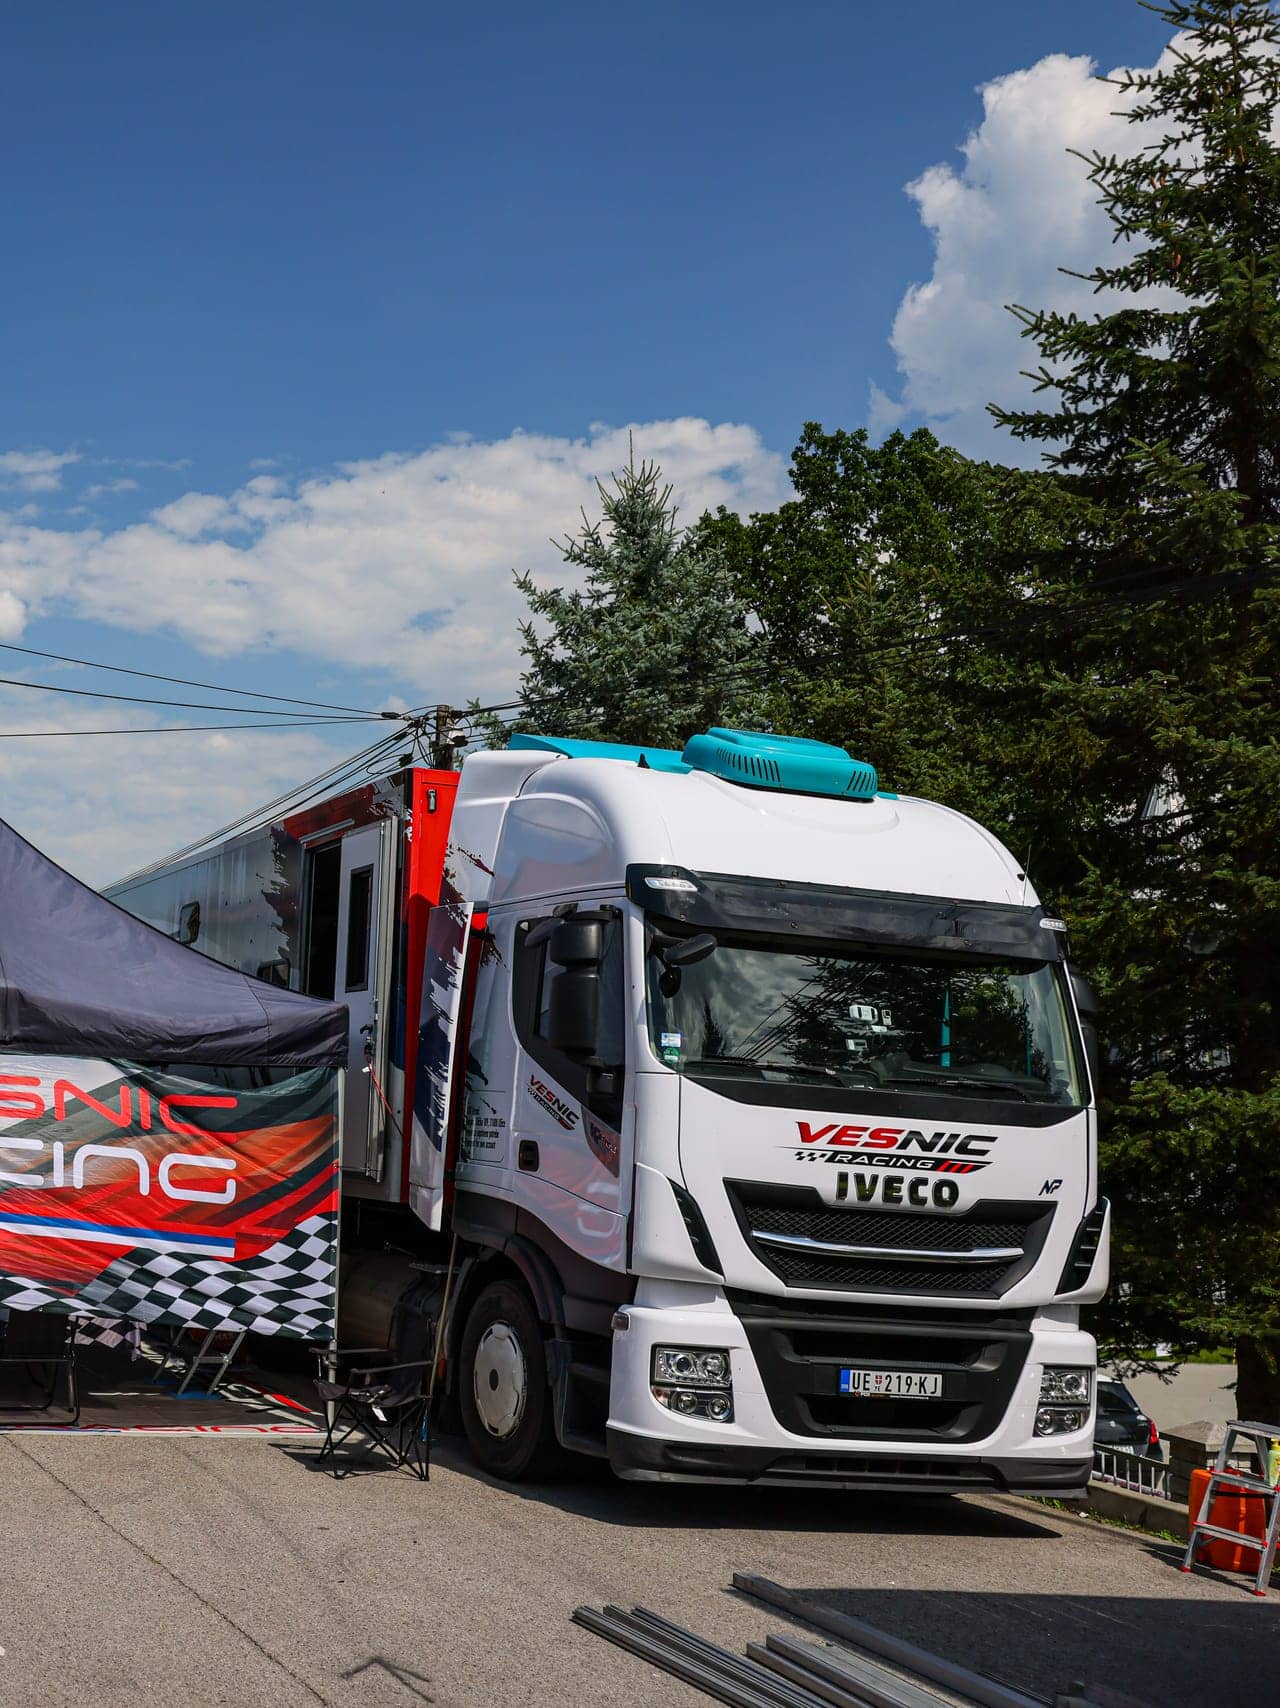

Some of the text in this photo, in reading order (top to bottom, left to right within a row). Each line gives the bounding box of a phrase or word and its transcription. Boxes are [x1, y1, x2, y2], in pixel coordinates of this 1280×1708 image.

[530, 1073, 581, 1126] VESNIC
[796, 1121, 999, 1156] VESNIC
[834, 1154, 934, 1168] RACING
[836, 1171, 960, 1208] IVECO
[851, 1371, 872, 1391] UE
